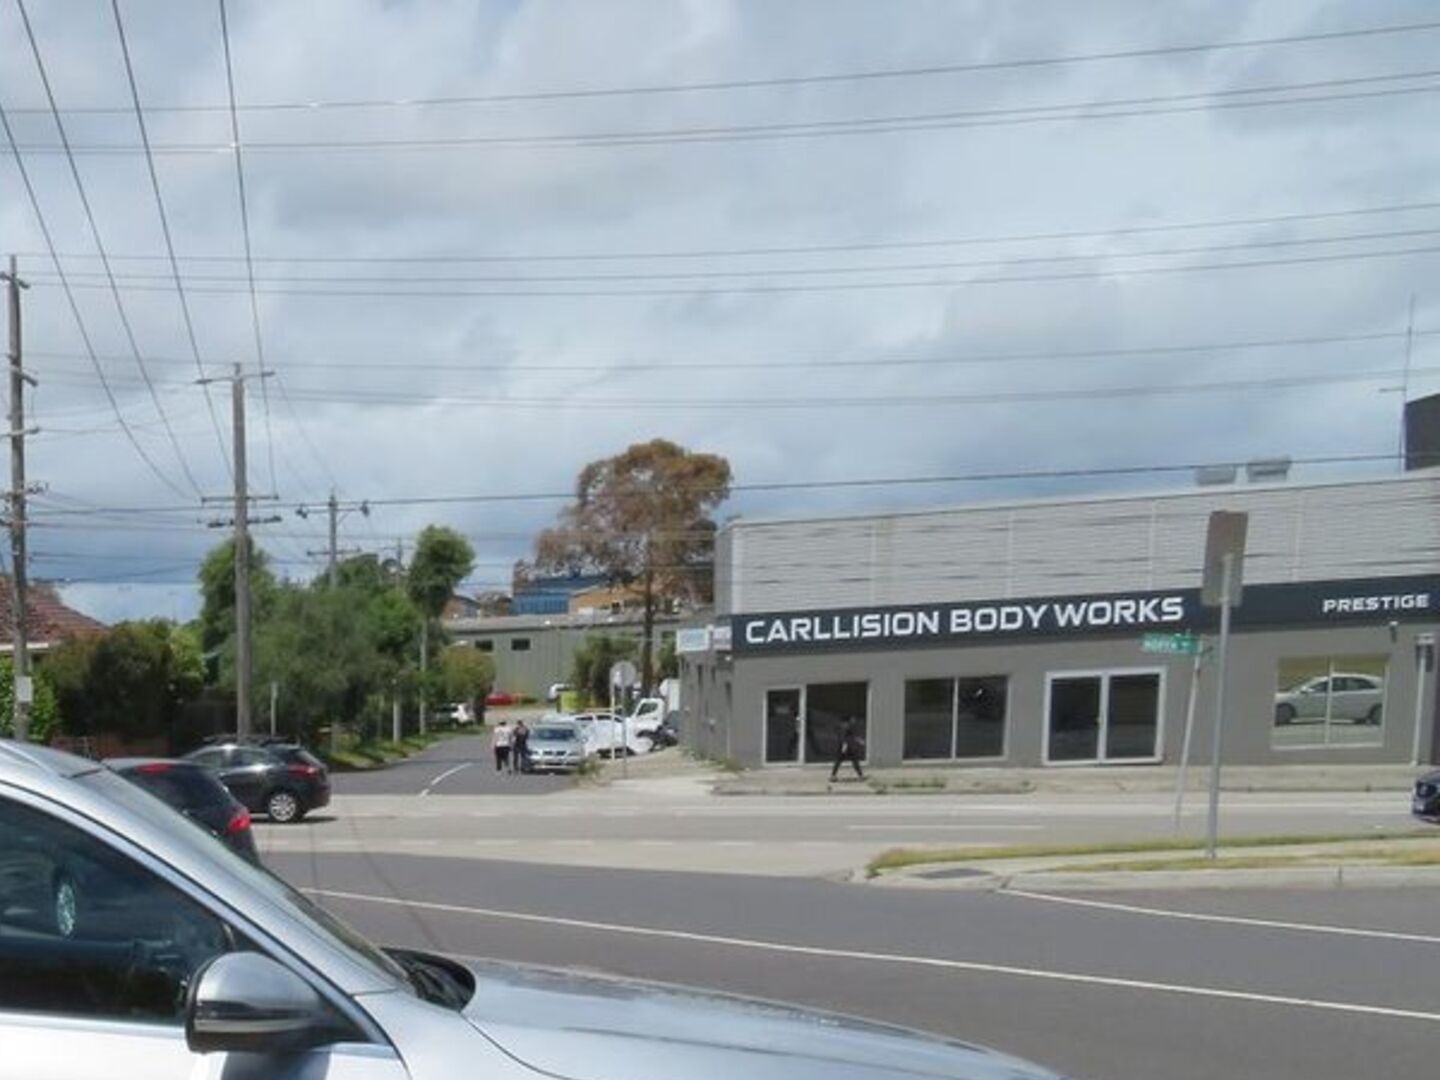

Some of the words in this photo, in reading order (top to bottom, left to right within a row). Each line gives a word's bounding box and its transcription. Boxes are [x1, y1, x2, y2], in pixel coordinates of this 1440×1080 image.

[1322, 593, 1431, 612] PRESTIGE
[745, 611, 940, 644] CARLLISION
[949, 604, 1048, 633] BODY
[1052, 597, 1184, 628] WORKS
